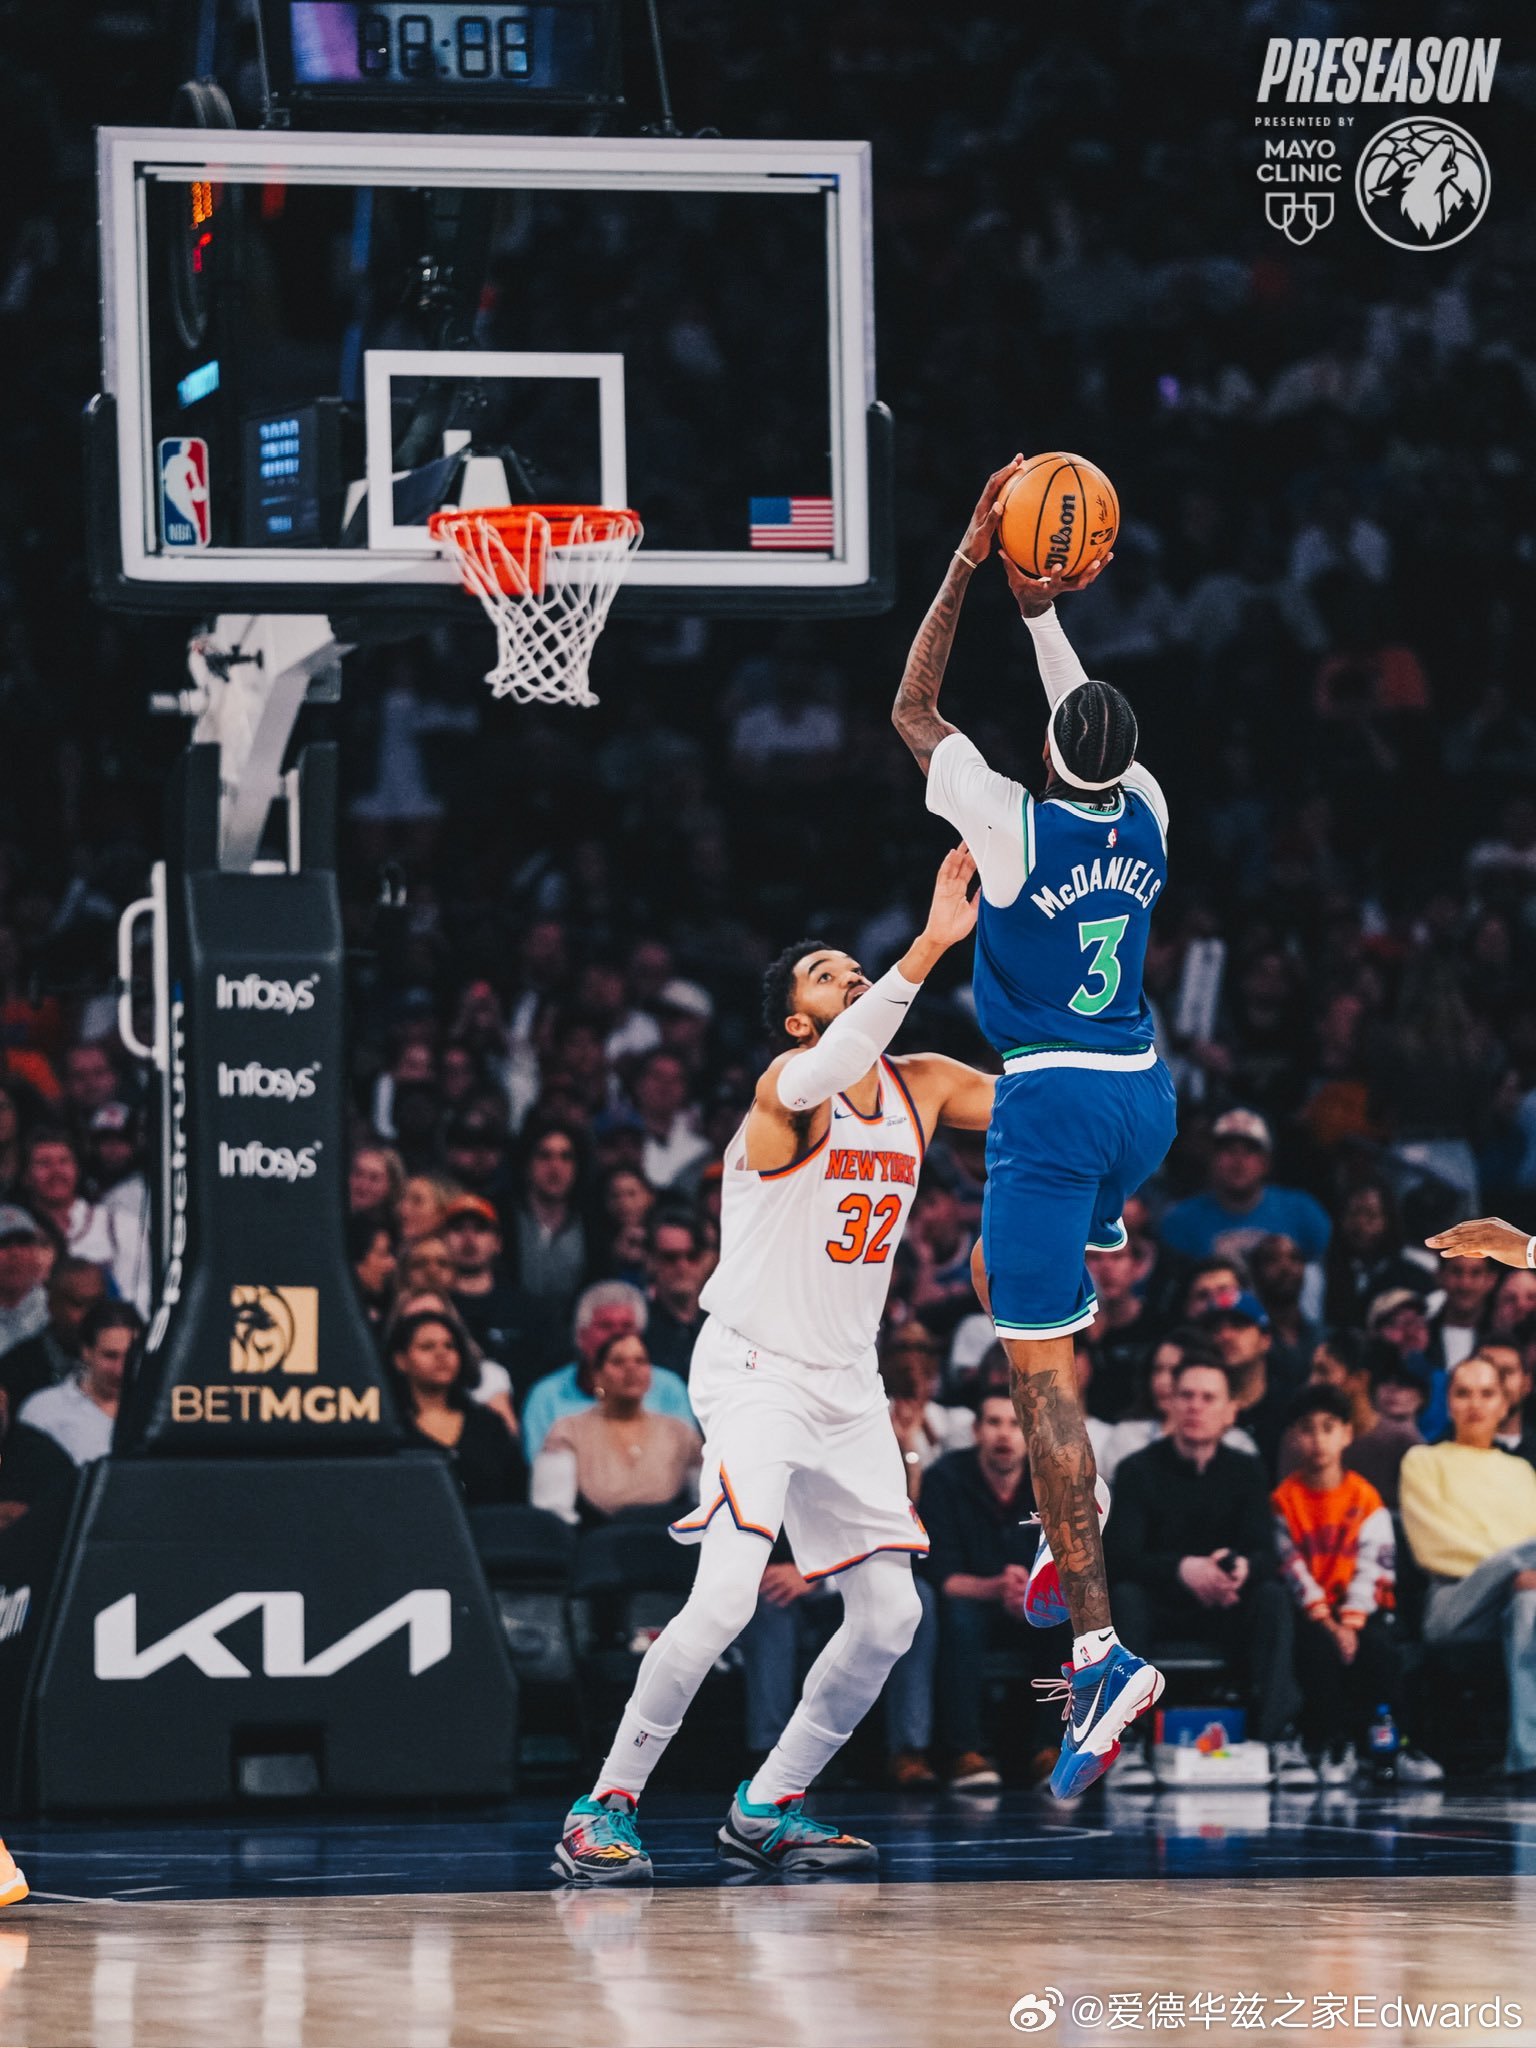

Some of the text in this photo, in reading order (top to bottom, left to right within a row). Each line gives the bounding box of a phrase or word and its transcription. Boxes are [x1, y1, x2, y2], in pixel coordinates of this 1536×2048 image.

[168, 523, 193, 542] NBA
[1044, 494, 1076, 570] Wilson
[1030, 856, 1162, 920] McDANIELS
[1067, 914, 1130, 1016] 3
[216, 973, 316, 1015] Infosys
[218, 1061, 319, 1103] Infosys
[219, 1140, 320, 1183] Infosys
[825, 1193, 902, 1265] 32
[171, 1384, 381, 1424] BETMGM
[94, 1589, 451, 1680] KIA
